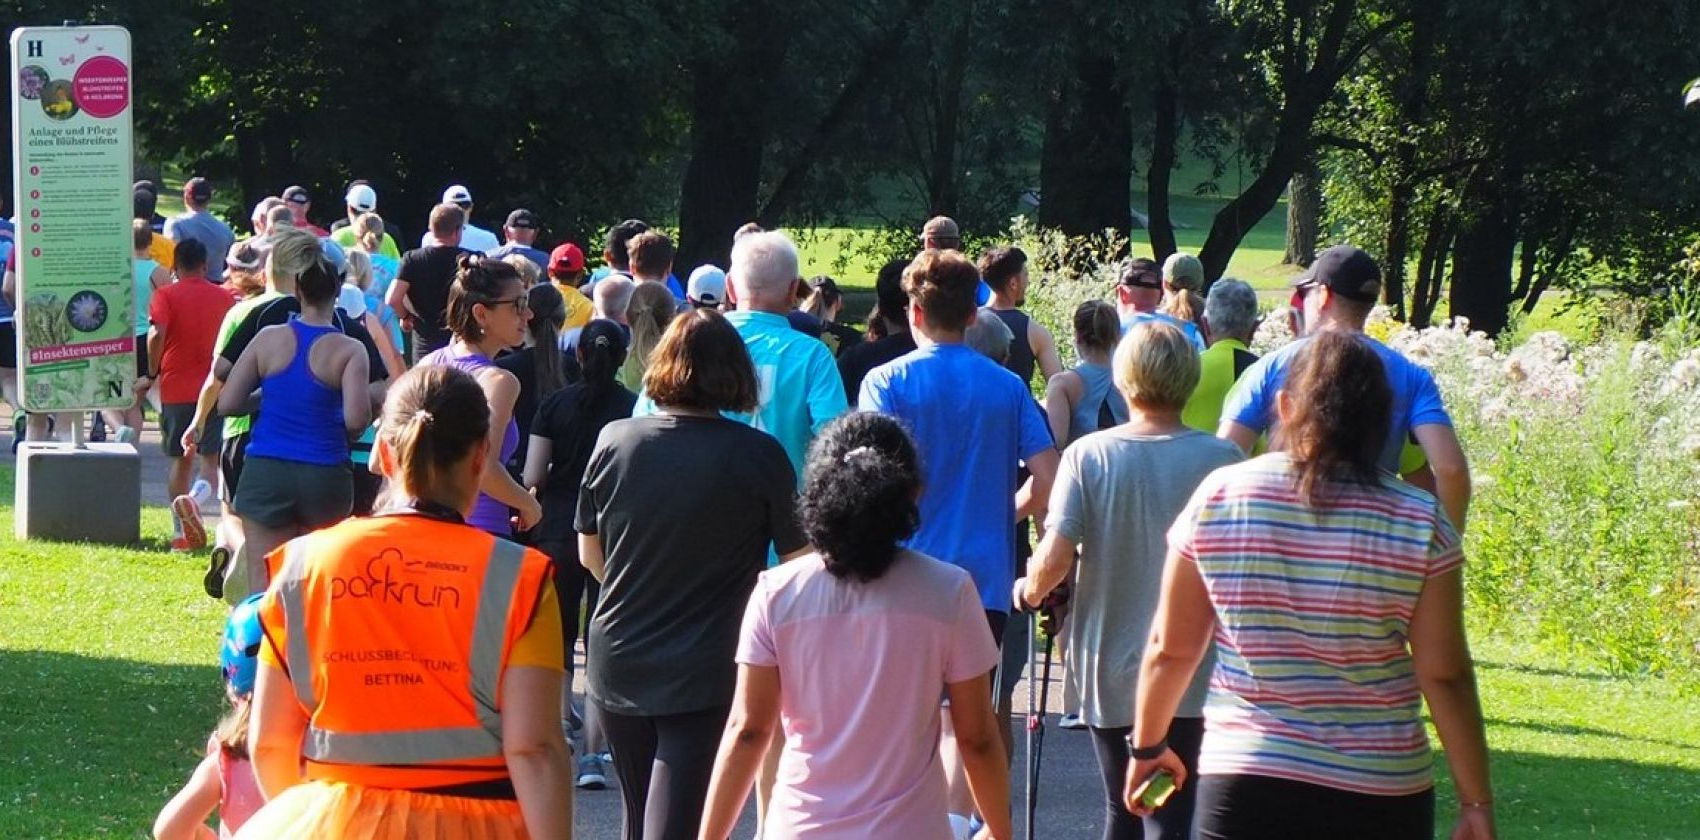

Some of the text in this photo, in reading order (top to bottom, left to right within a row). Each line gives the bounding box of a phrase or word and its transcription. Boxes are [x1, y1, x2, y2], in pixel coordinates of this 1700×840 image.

[27, 39, 43, 58] H
[29, 125, 117, 137] Anlage und Pflege
[29, 136, 118, 146] eines Blühstreifens
[32, 341, 124, 361] #Insektenvesper
[108, 380, 123, 398] N
[330, 563, 460, 609] parkrun
[364, 673, 425, 686] BETTINA
